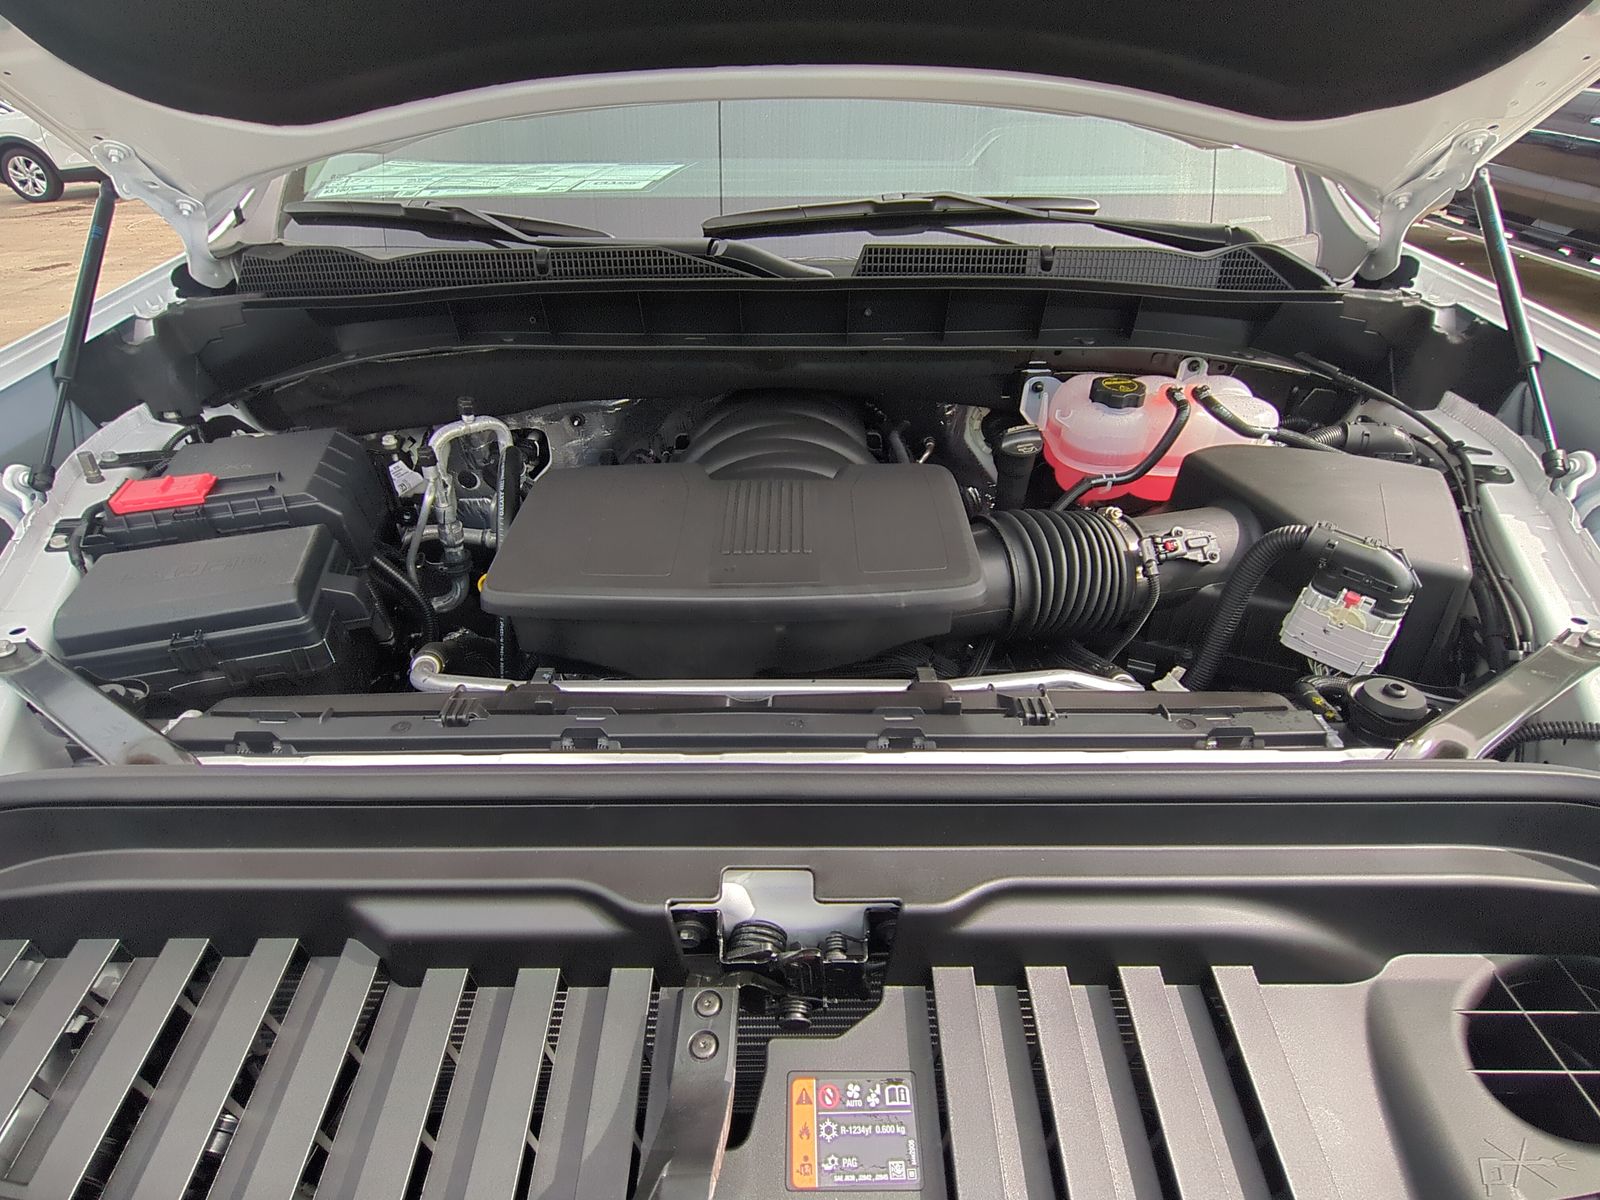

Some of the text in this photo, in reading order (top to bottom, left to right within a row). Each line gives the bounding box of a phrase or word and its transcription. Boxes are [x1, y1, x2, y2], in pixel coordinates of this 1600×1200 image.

[846, 1099, 862, 1107] AUTO
[840, 1124, 906, 1136] R-1234yf 0.600 kg
[842, 1157, 858, 1168] PAG
